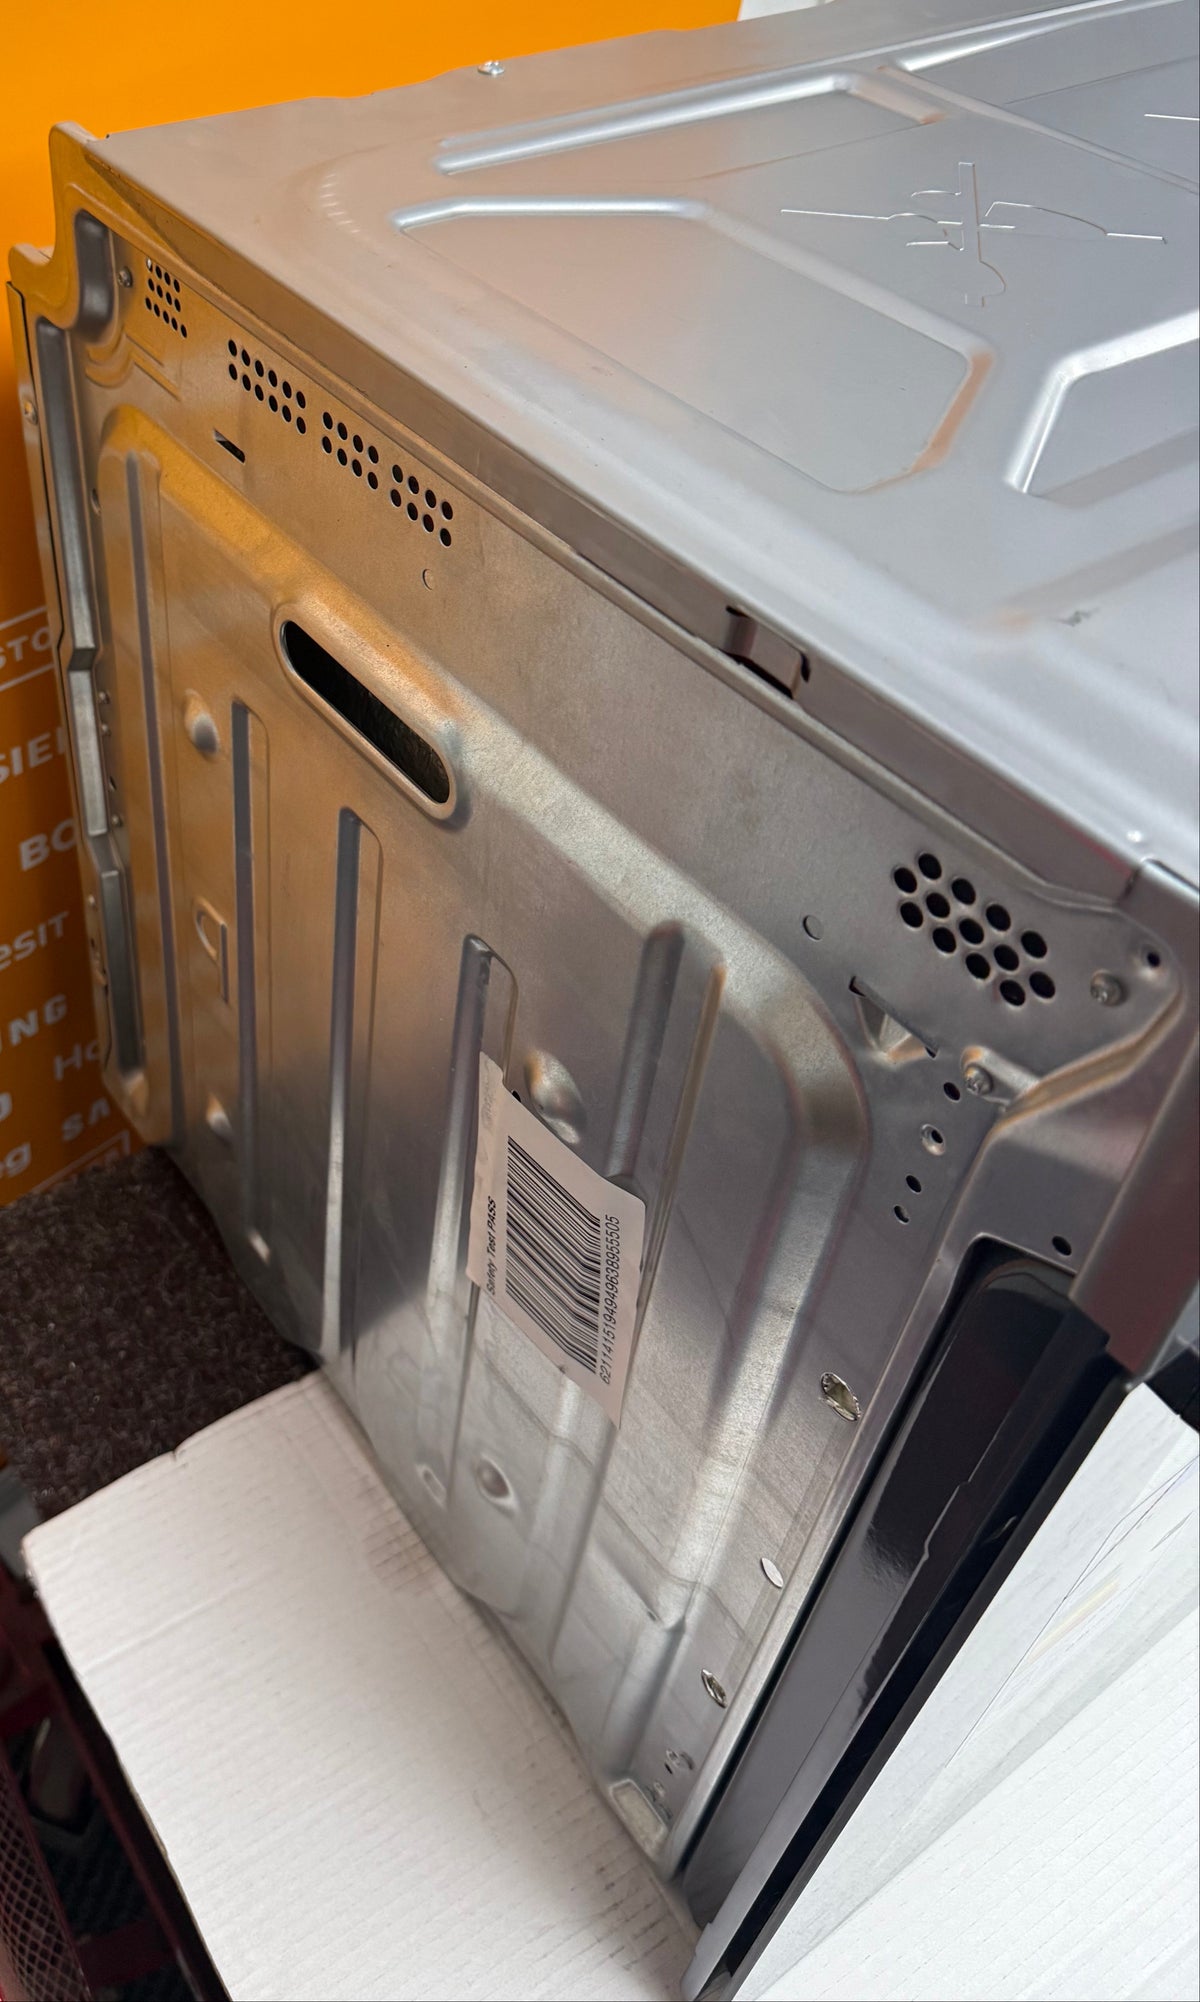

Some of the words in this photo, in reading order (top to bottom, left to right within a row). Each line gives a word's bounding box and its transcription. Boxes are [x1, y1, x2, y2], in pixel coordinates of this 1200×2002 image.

[0, 994, 67, 1053] NG
[487, 1195, 497, 1232] PASS
[487, 1231, 496, 1257] Test
[486, 1259, 497, 1296] Safety
[600, 1214, 620, 1384] 6211415194949638955505
